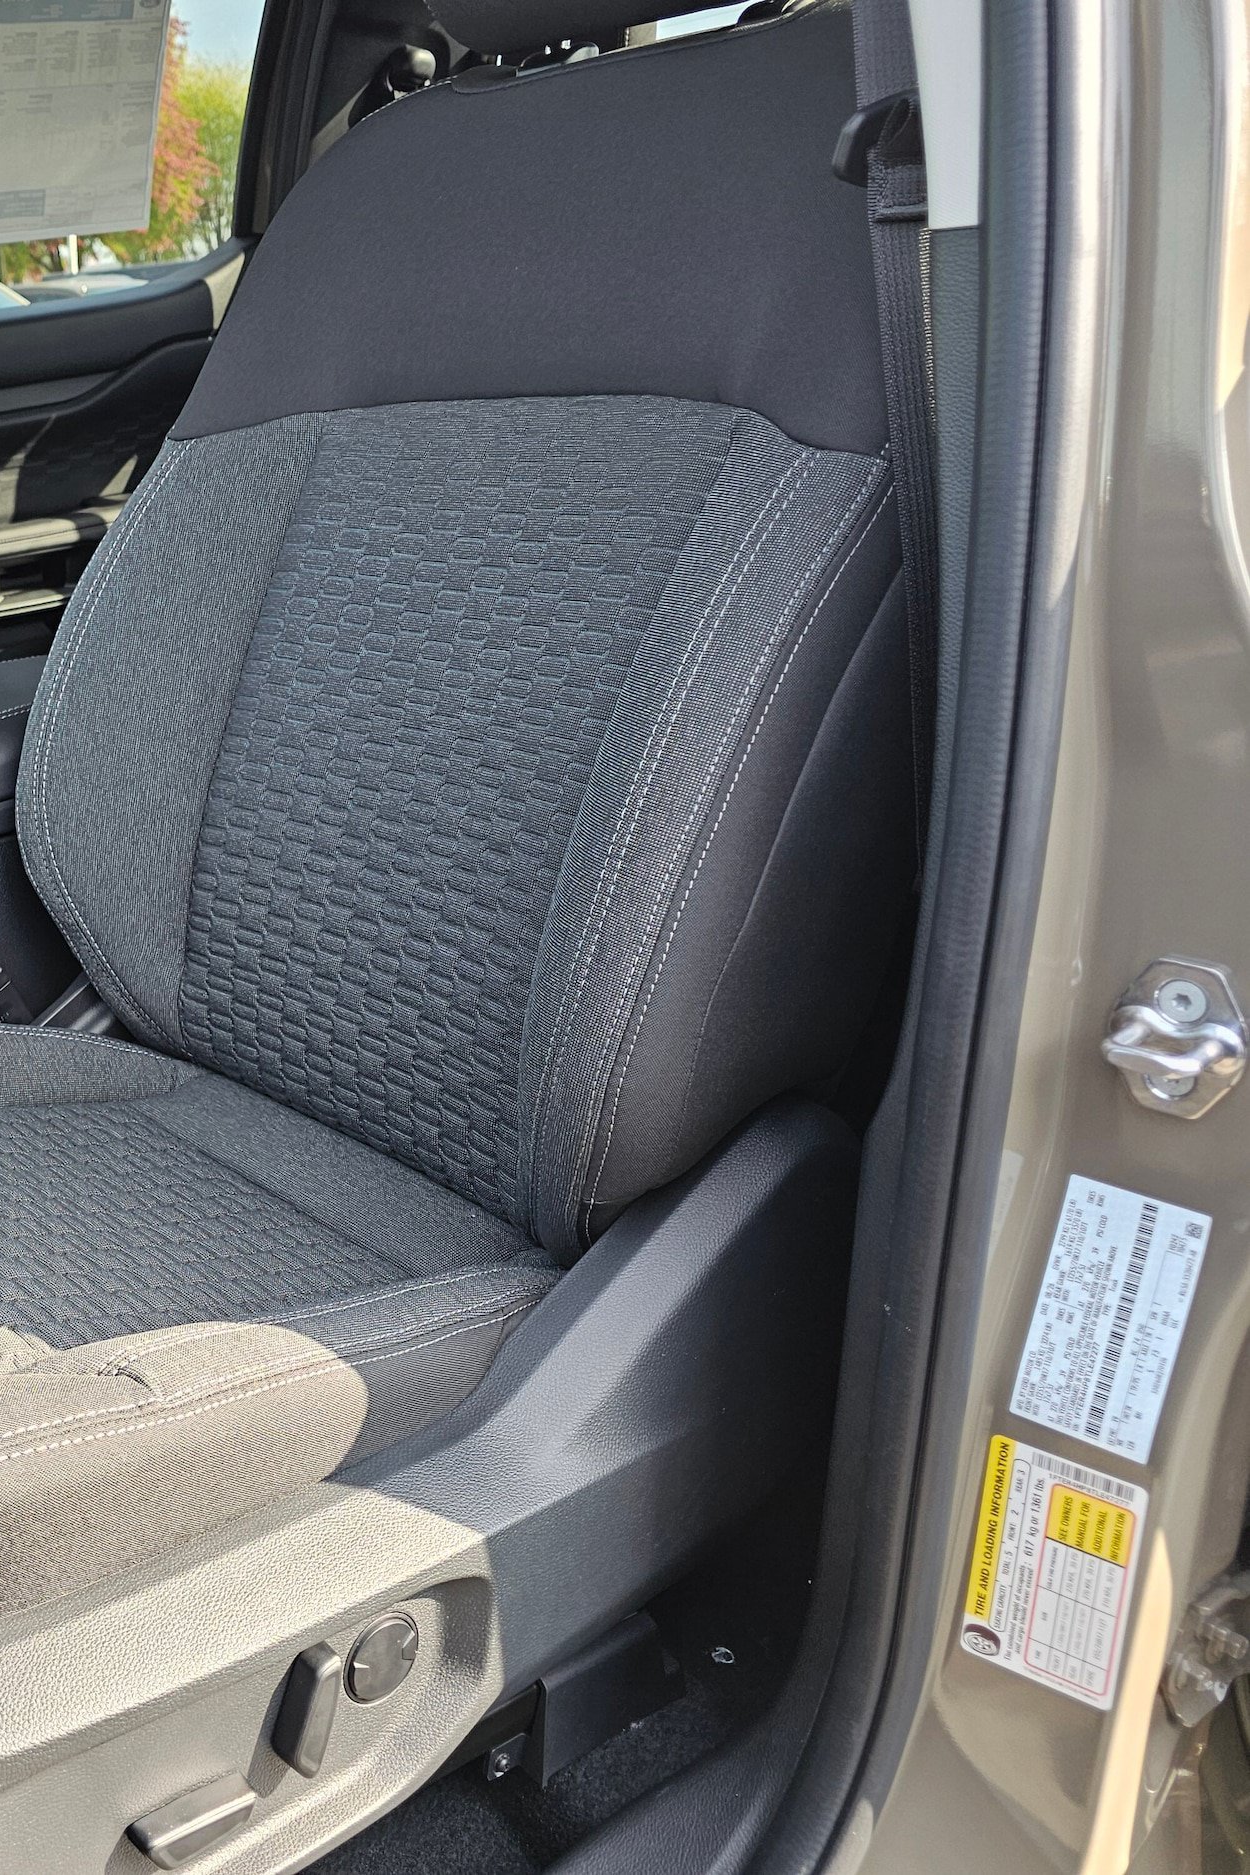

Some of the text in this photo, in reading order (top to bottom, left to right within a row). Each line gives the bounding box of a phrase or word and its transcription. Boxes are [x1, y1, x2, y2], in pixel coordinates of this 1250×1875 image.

[1098, 1214, 1108, 1229] COLD
[1096, 1228, 1104, 1238] PSI
[1094, 1261, 1104, 1281] VEHICLE
[1102, 1262, 1113, 1282] SHOWN
[1053, 1286, 1062, 1300] REAR
[1082, 1281, 1091, 1292] 270
[1089, 1281, 1099, 1299] MOTOR
[1083, 1300, 1094, 1321] FEDERAL
[1092, 1283, 1107, 1319] MANUFACTURE
[1076, 1322, 1088, 1350] APPLICABLE
[1087, 1327, 1096, 1340] DATE
[1066, 1337, 1075, 1351] COLD
[1064, 1351, 1072, 1360] PSI
[1024, 1359, 1034, 1377] MOTOR
[1077, 1359, 1087, 1376] EFFECT
[1021, 1377, 1030, 1390] FORD
[1064, 1367, 1076, 1395] CONFORMS
[1074, 1342, 1100, 1420] 1FTER4HP8TLE47277
[1024, 1398, 1033, 1413] FRONT
[1059, 1395, 1069, 1414] VEHICLE
[1068, 1383, 1081, 1411] STANDARDS
[1050, 1402, 1058, 1412] 270
[1056, 1414, 1064, 1425] THIS
[1064, 1412, 1073, 1428] SAFETY
[1023, 1476, 1045, 1558] 617 kg or 1361 lbs.
[1058, 1495, 1073, 1542] SEE OWNERS
[1075, 1501, 1091, 1548] MANUAL FOR
[974, 1441, 1010, 1617] TIRE AND LOADING INFORMATION
[1092, 1509, 1108, 1553] ADDITIONAL
[1109, 1510, 1126, 1562] INFORMATION
[1016, 1564, 1027, 1595] occupants
[1026, 1568, 1034, 1588] exceed
[994, 1584, 1007, 1629] SEATING CAPACITY
[1011, 1601, 1021, 1622] weight
[1020, 1606, 1028, 1625] should
[1006, 1621, 1017, 1650] combined
[1017, 1625, 1026, 1643] cargo
[1004, 1649, 1012, 1661] The
